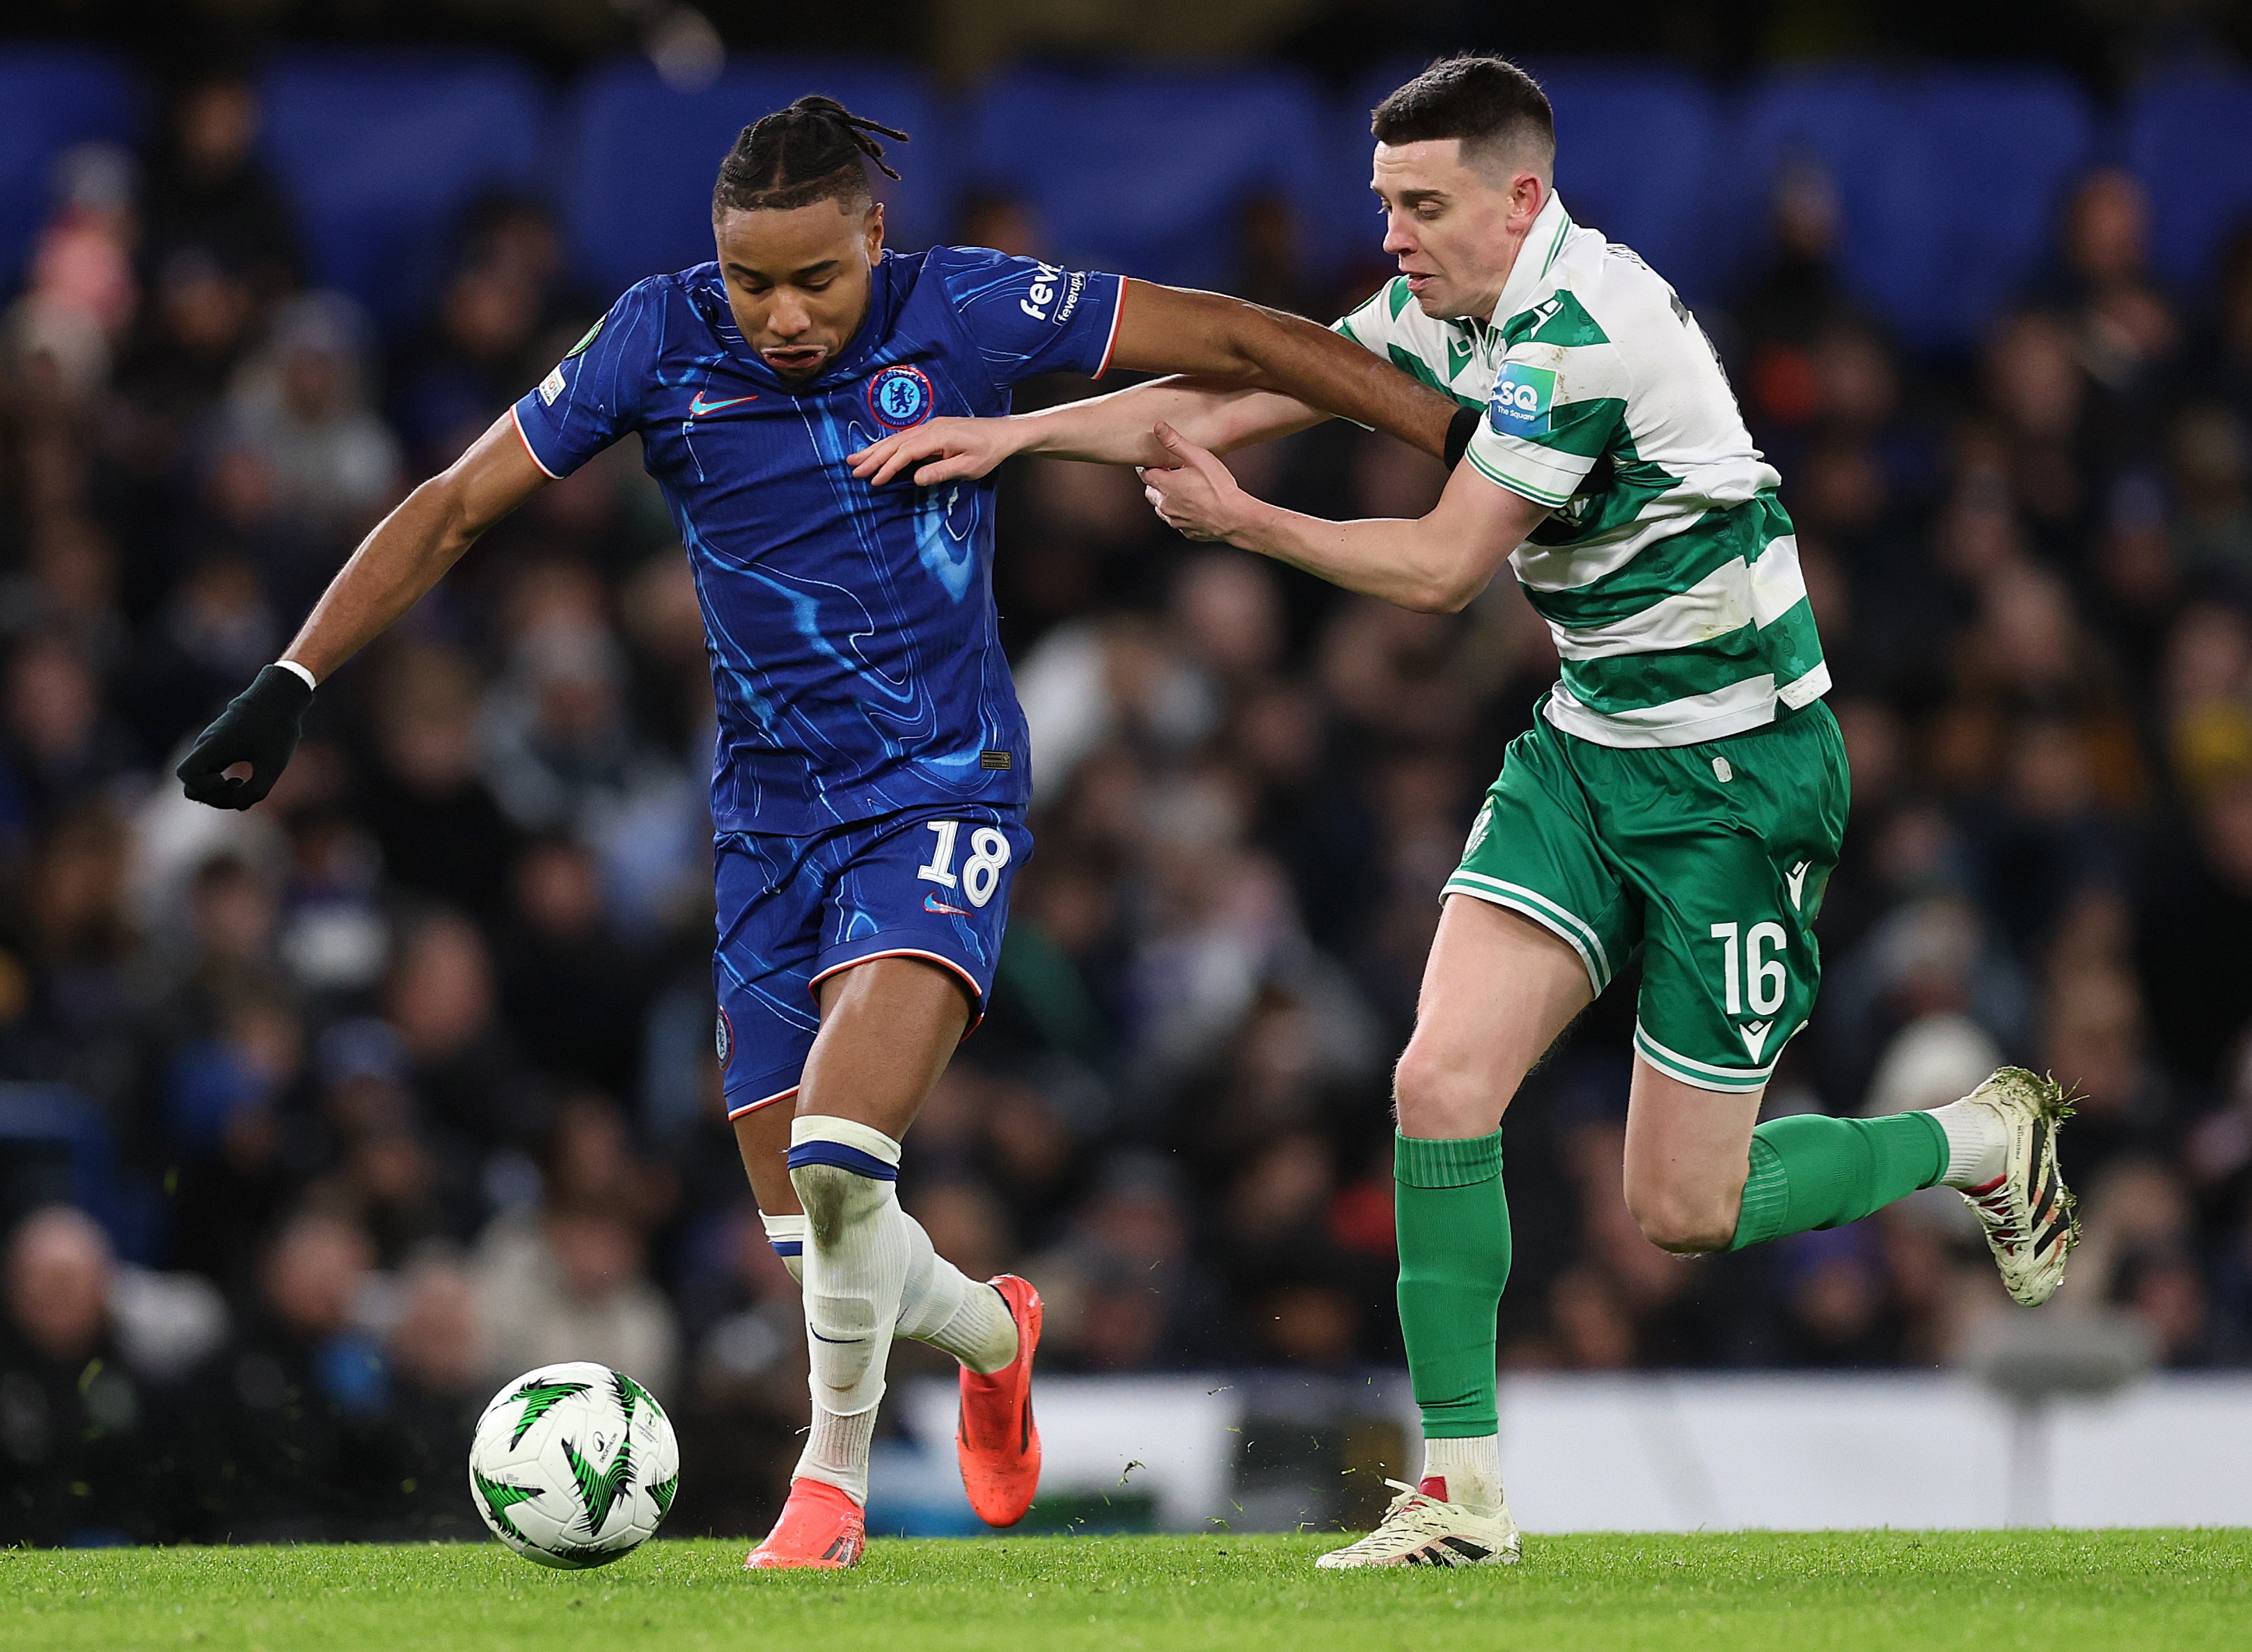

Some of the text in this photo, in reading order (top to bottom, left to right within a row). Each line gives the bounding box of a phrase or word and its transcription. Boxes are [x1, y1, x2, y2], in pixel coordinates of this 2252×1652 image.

[1497, 405, 1536, 421] The Square
[1498, 381, 1538, 411] SQ
[918, 821, 1011, 908] 18
[1710, 921, 1787, 1016] 16
